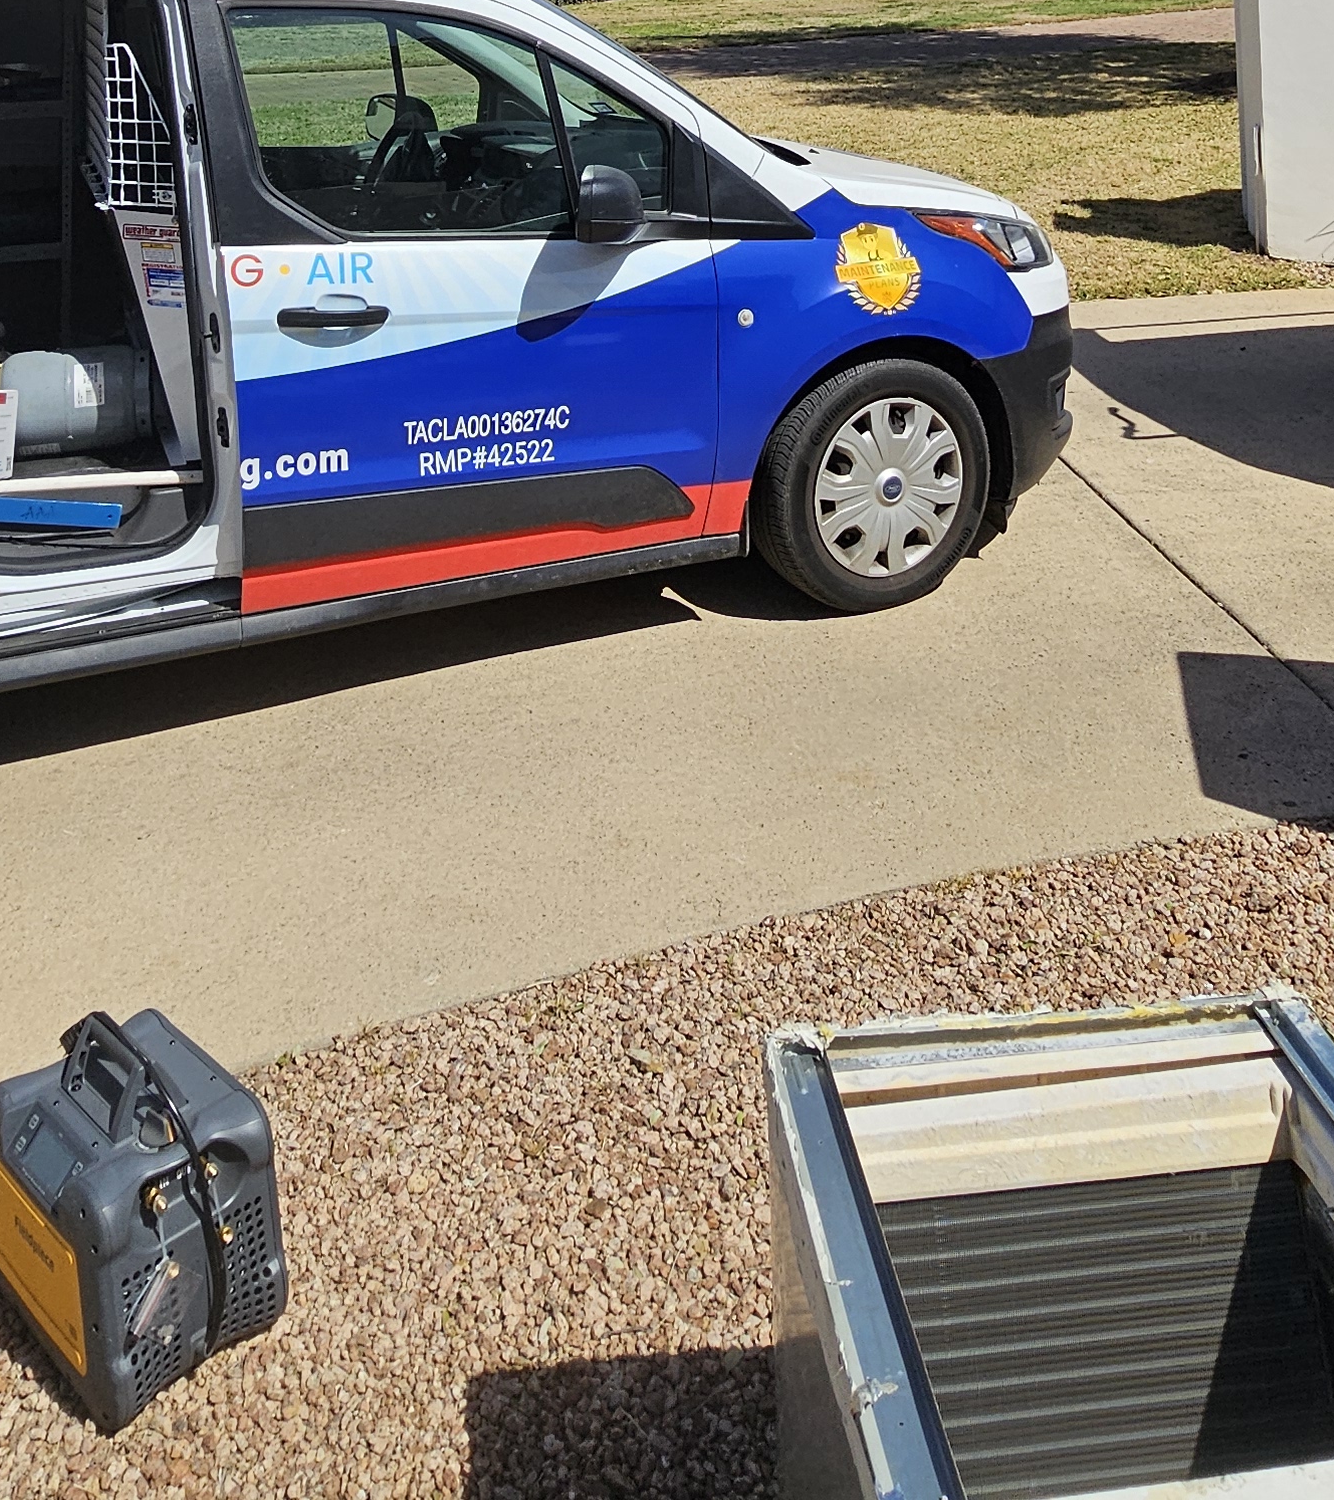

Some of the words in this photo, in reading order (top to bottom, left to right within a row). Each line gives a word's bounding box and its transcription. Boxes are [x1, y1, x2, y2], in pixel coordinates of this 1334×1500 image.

[307, 252, 374, 285] AIR
[839, 259, 917, 279] MAINTENANCE
[869, 276, 900, 290] PLANS
[403, 405, 571, 445] TACLA00136274C
[240, 447, 350, 491] g.com
[419, 438, 556, 477] RMP#42522
